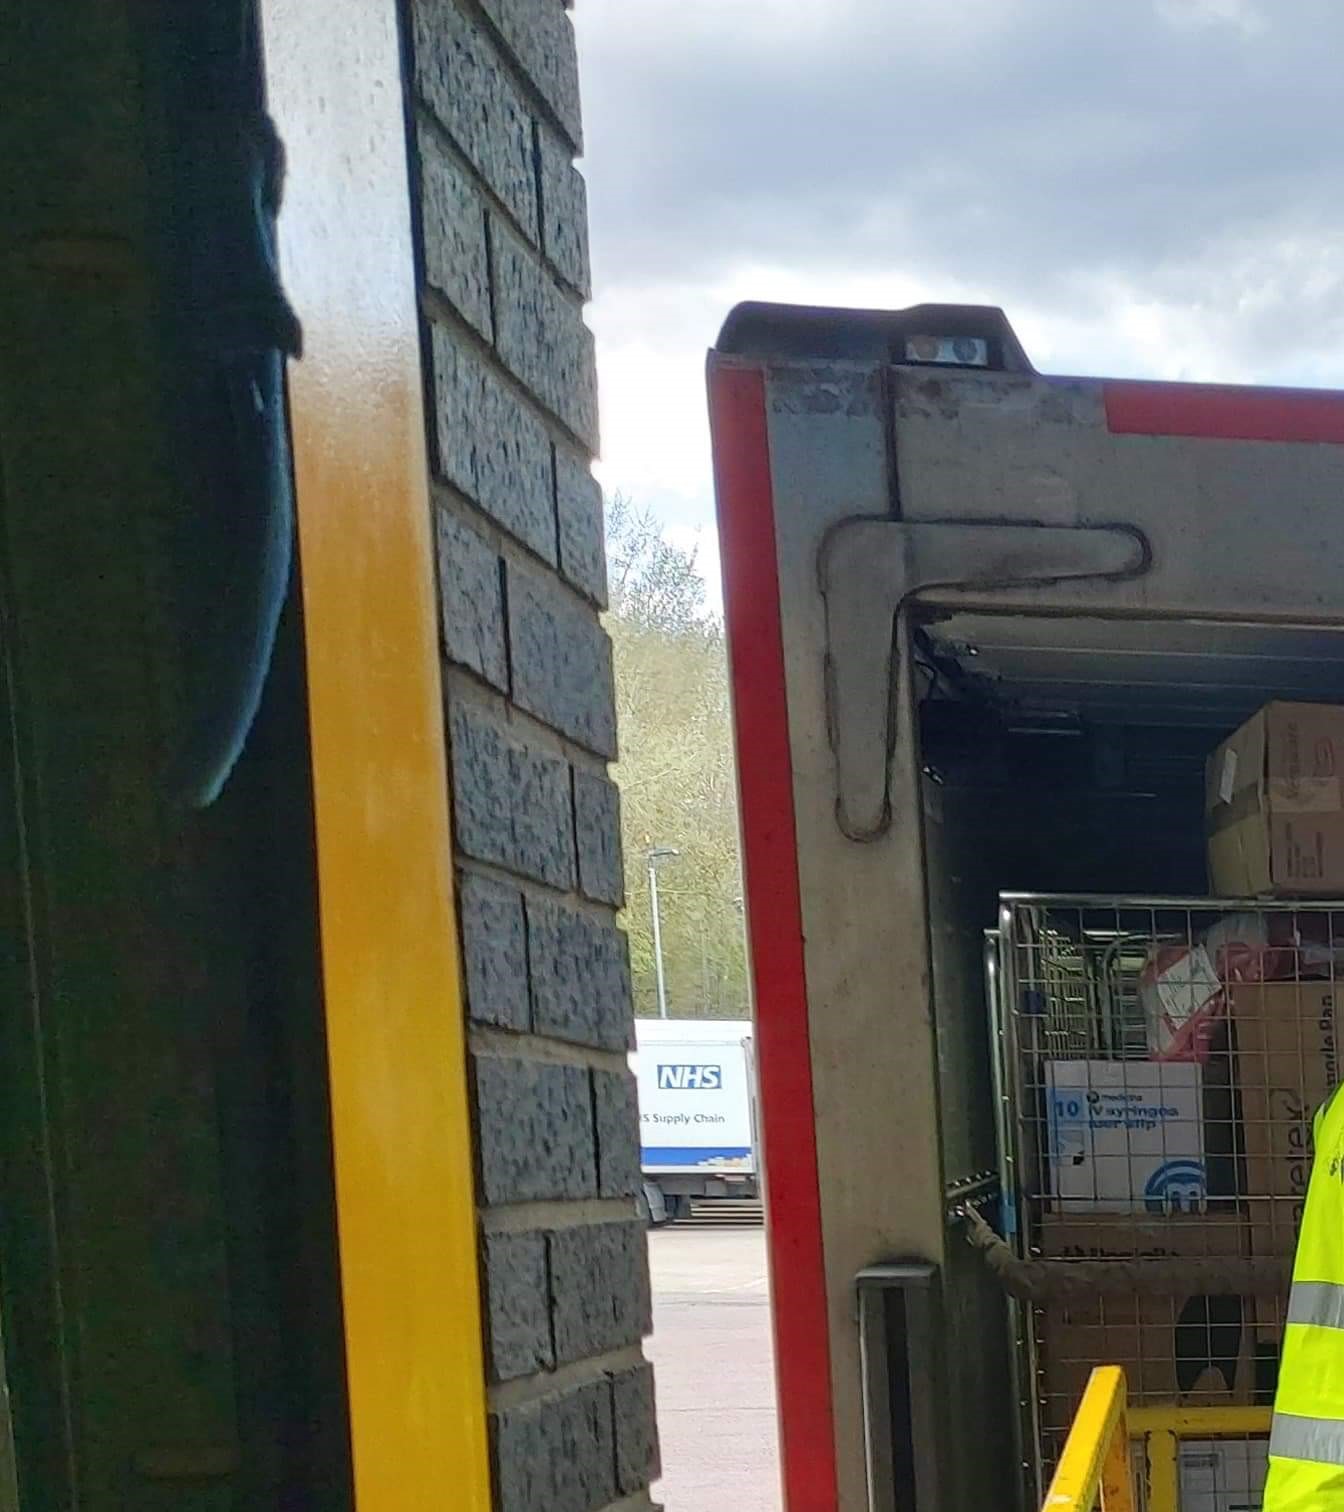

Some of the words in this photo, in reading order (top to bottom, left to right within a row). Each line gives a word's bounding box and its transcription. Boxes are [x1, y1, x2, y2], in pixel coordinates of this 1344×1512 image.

[658, 1065, 721, 1089] NHS
[1055, 1101, 1079, 1117] 10
[653, 1113, 690, 1125] Supply
[693, 1113, 725, 1124] Chain
